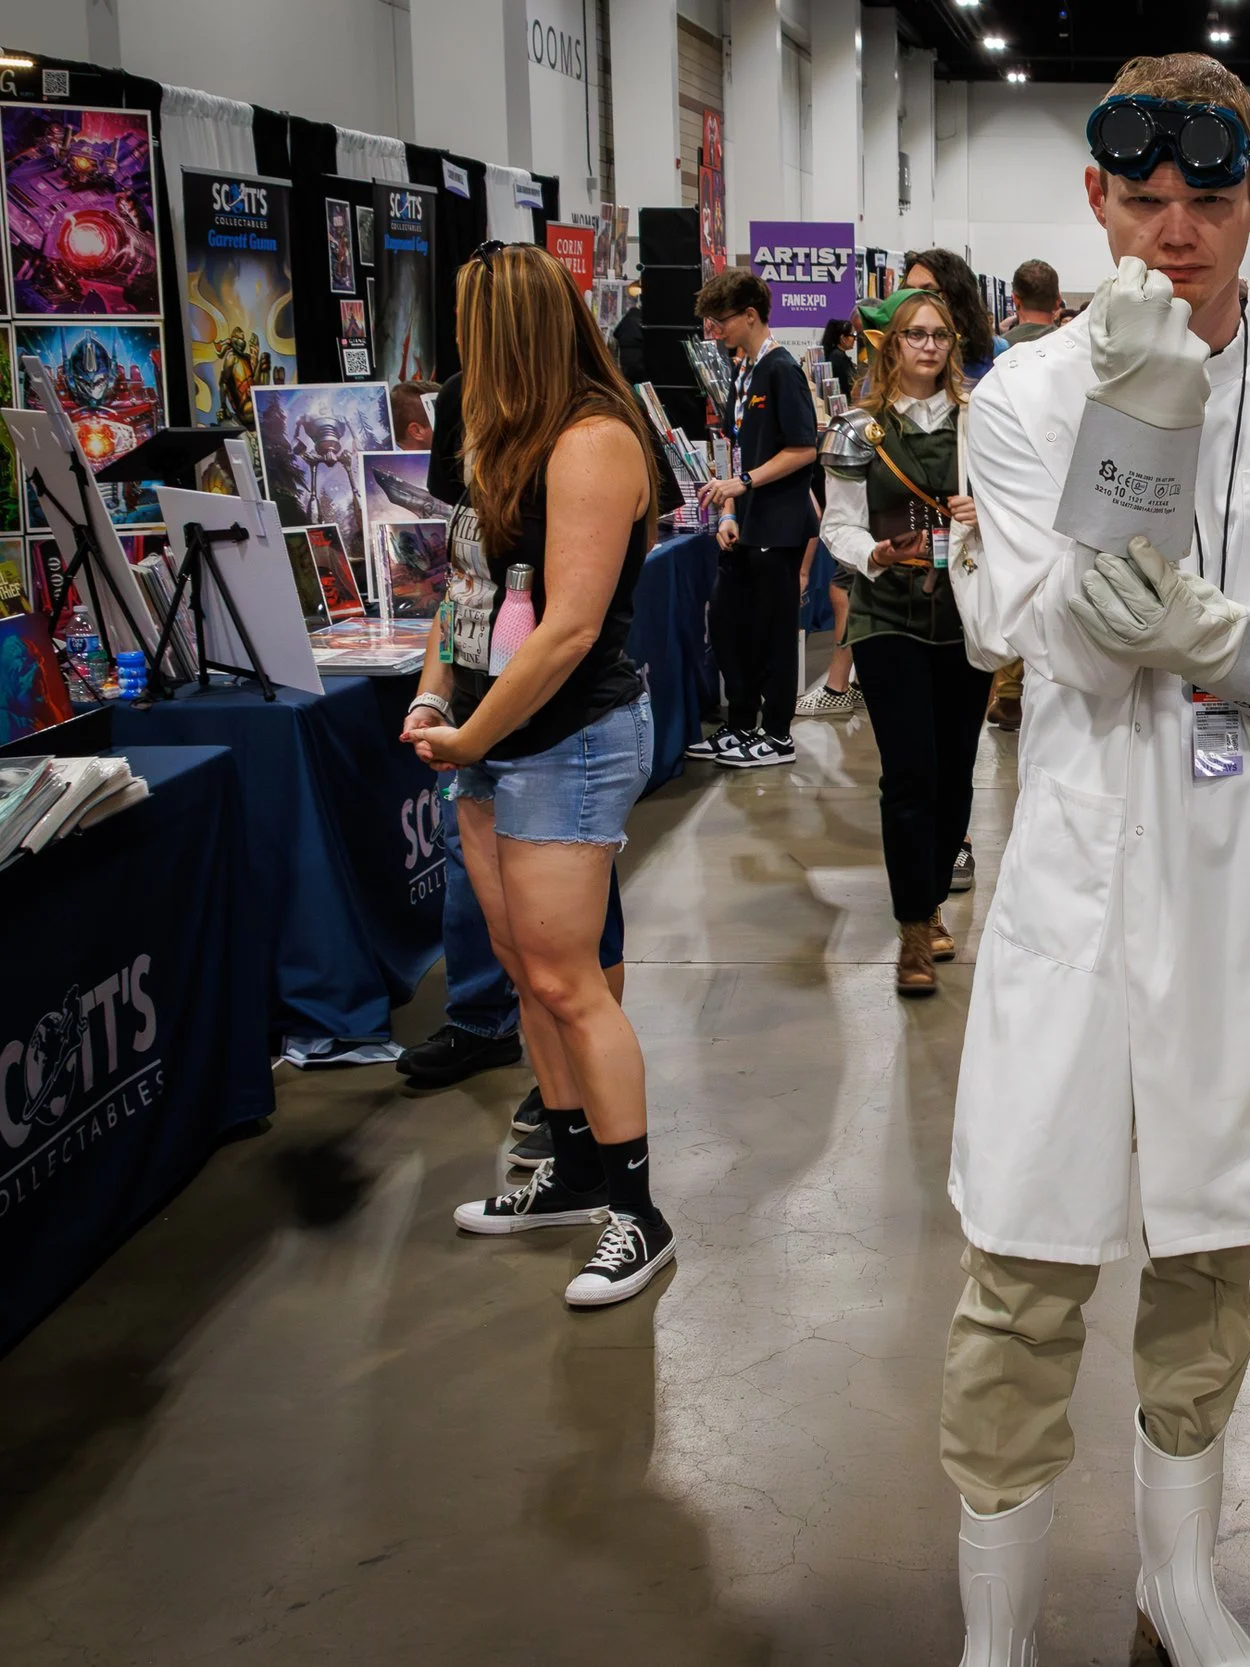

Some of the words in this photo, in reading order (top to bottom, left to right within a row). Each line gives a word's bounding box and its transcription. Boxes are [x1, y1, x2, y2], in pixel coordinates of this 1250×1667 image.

[528, 19, 582, 80] OOMS
[214, 216, 268, 230] COLLECTABLES
[208, 229, 247, 249] Garrett
[249, 235, 277, 252] Gunn
[556, 238, 583, 254] CORIN
[754, 246, 852, 265] ARTIST
[557, 257, 587, 274] OWELL
[760, 264, 847, 282] ALLEY
[781, 293, 827, 308] FANEXPO
[1094, 484, 1112, 496] 3210
[1114, 485, 1126, 498] 10
[410, 866, 447, 905] COLL
